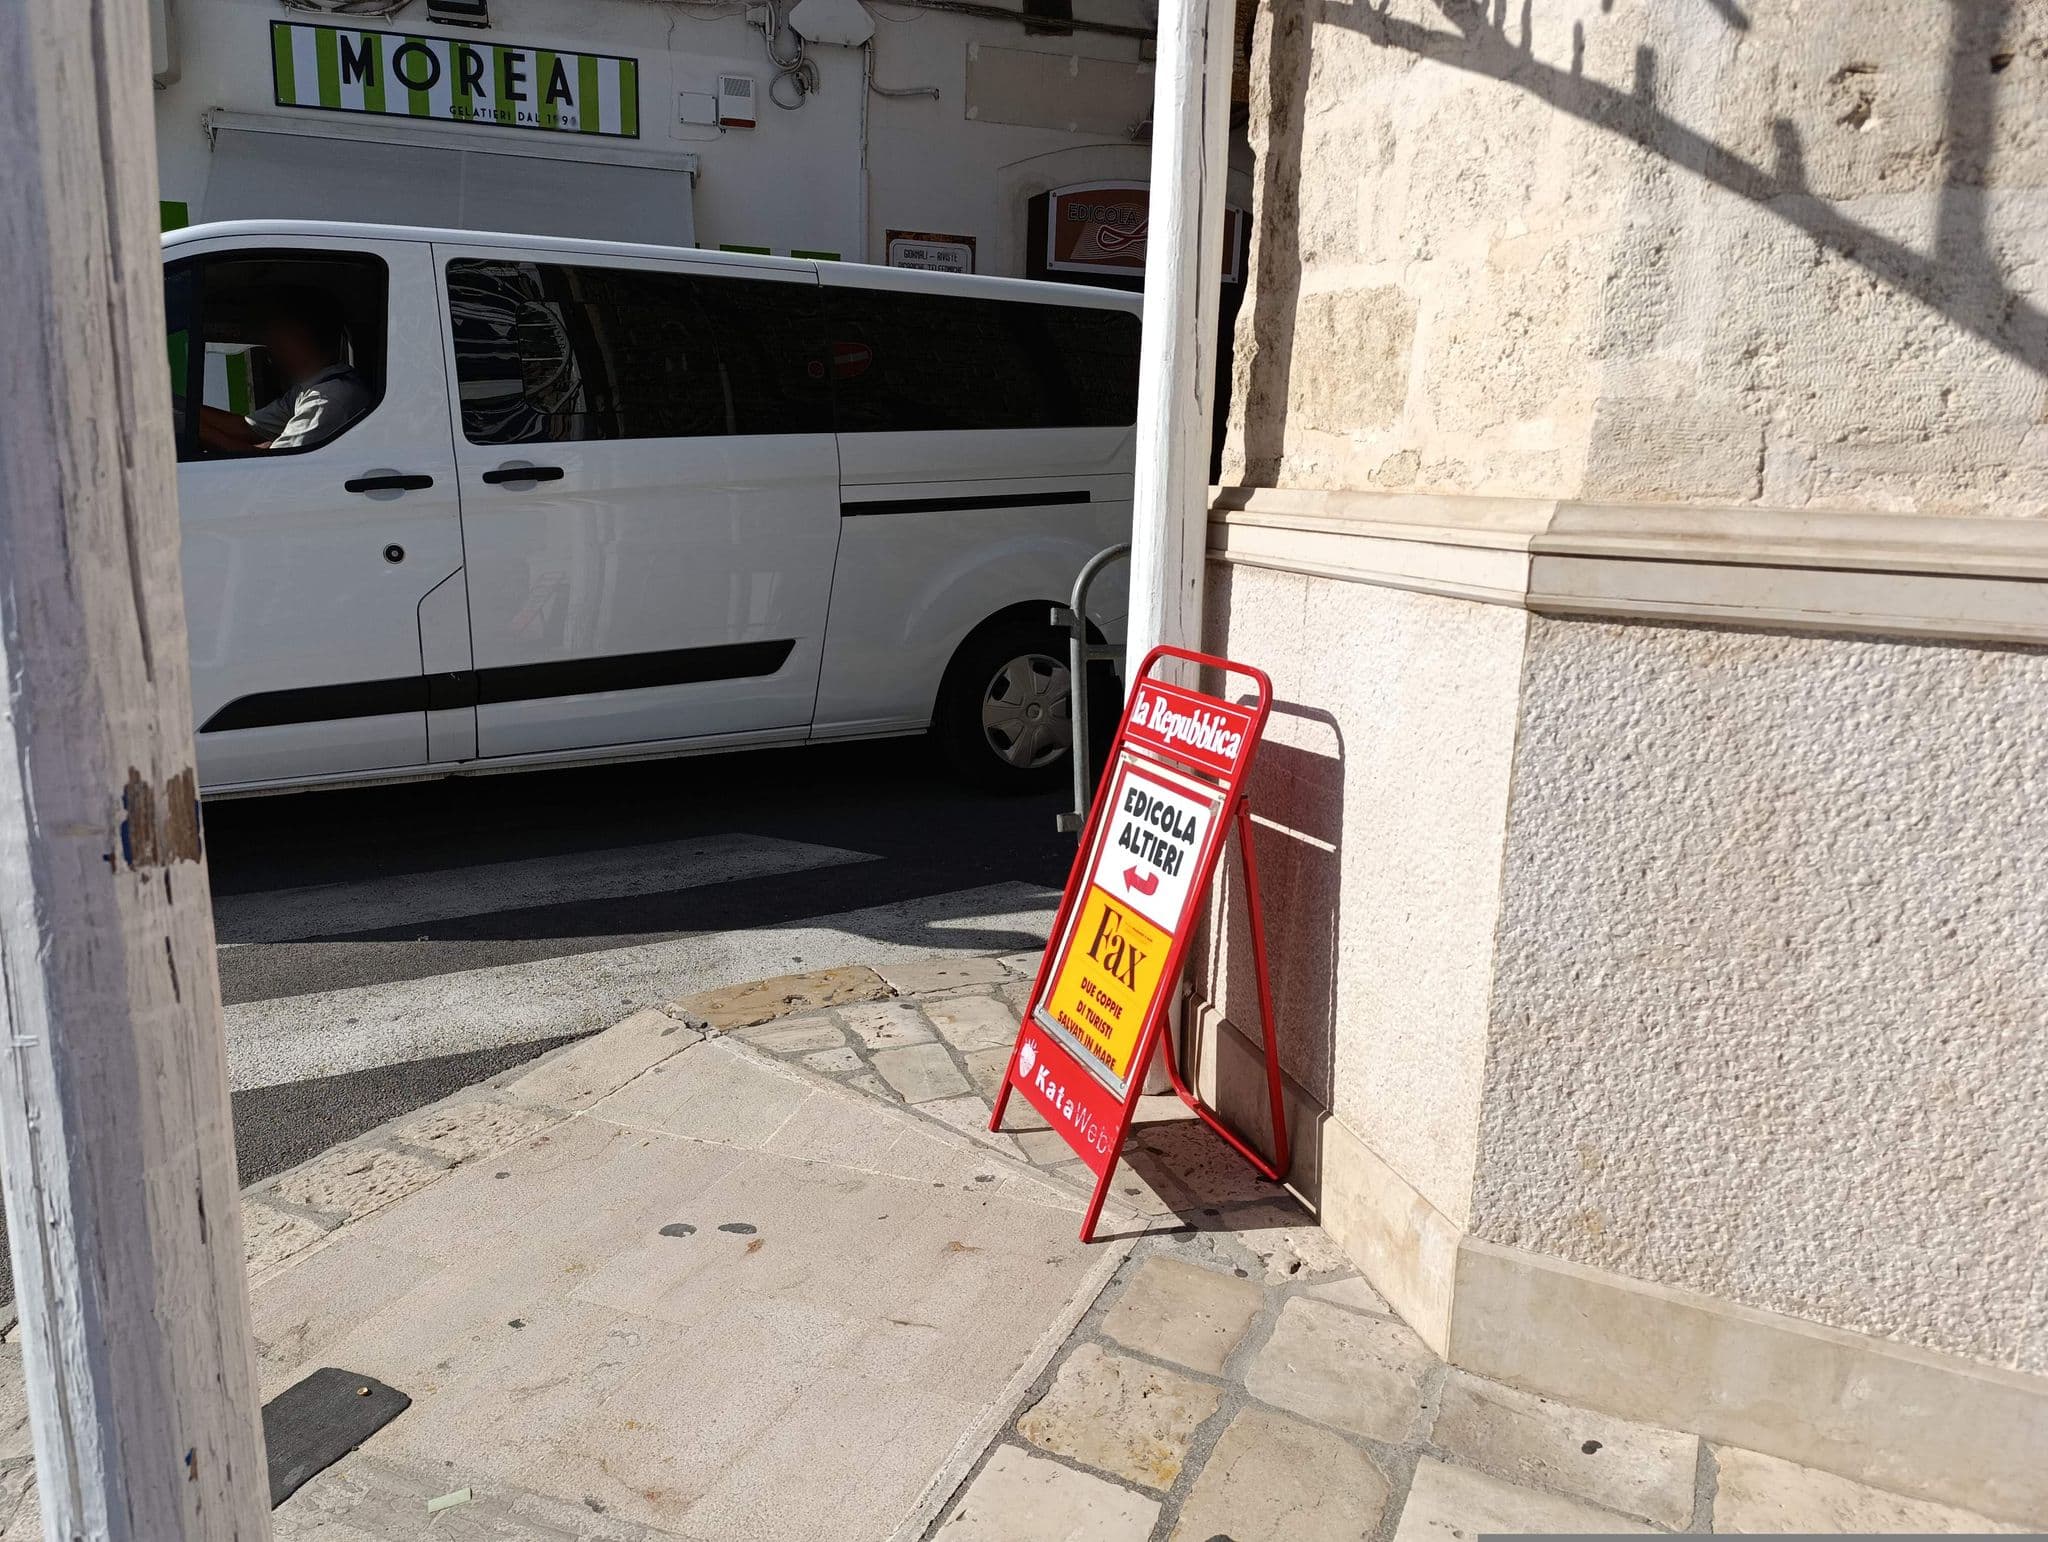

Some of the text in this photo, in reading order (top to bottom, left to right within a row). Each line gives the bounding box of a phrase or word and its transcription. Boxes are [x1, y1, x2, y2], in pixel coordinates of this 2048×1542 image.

[340, 34, 573, 106] MOREA
[449, 105, 511, 120] GELATIERI
[518, 111, 540, 123] DAL
[1067, 203, 1137, 225] EDICOLA
[1131, 691, 1241, 759] la Repubblica
[1124, 787, 1197, 845] EDICOLA
[1118, 822, 1184, 877] ALTIERI
[1086, 903, 1147, 992] Fax
[1076, 1000, 1112, 1039] DI TURISTI
[1080, 976, 1123, 1020] DUE COPPIE
[1057, 1010, 1117, 1070] SALVATI IN MARE
[1034, 1063, 1109, 1154] KataWeb
